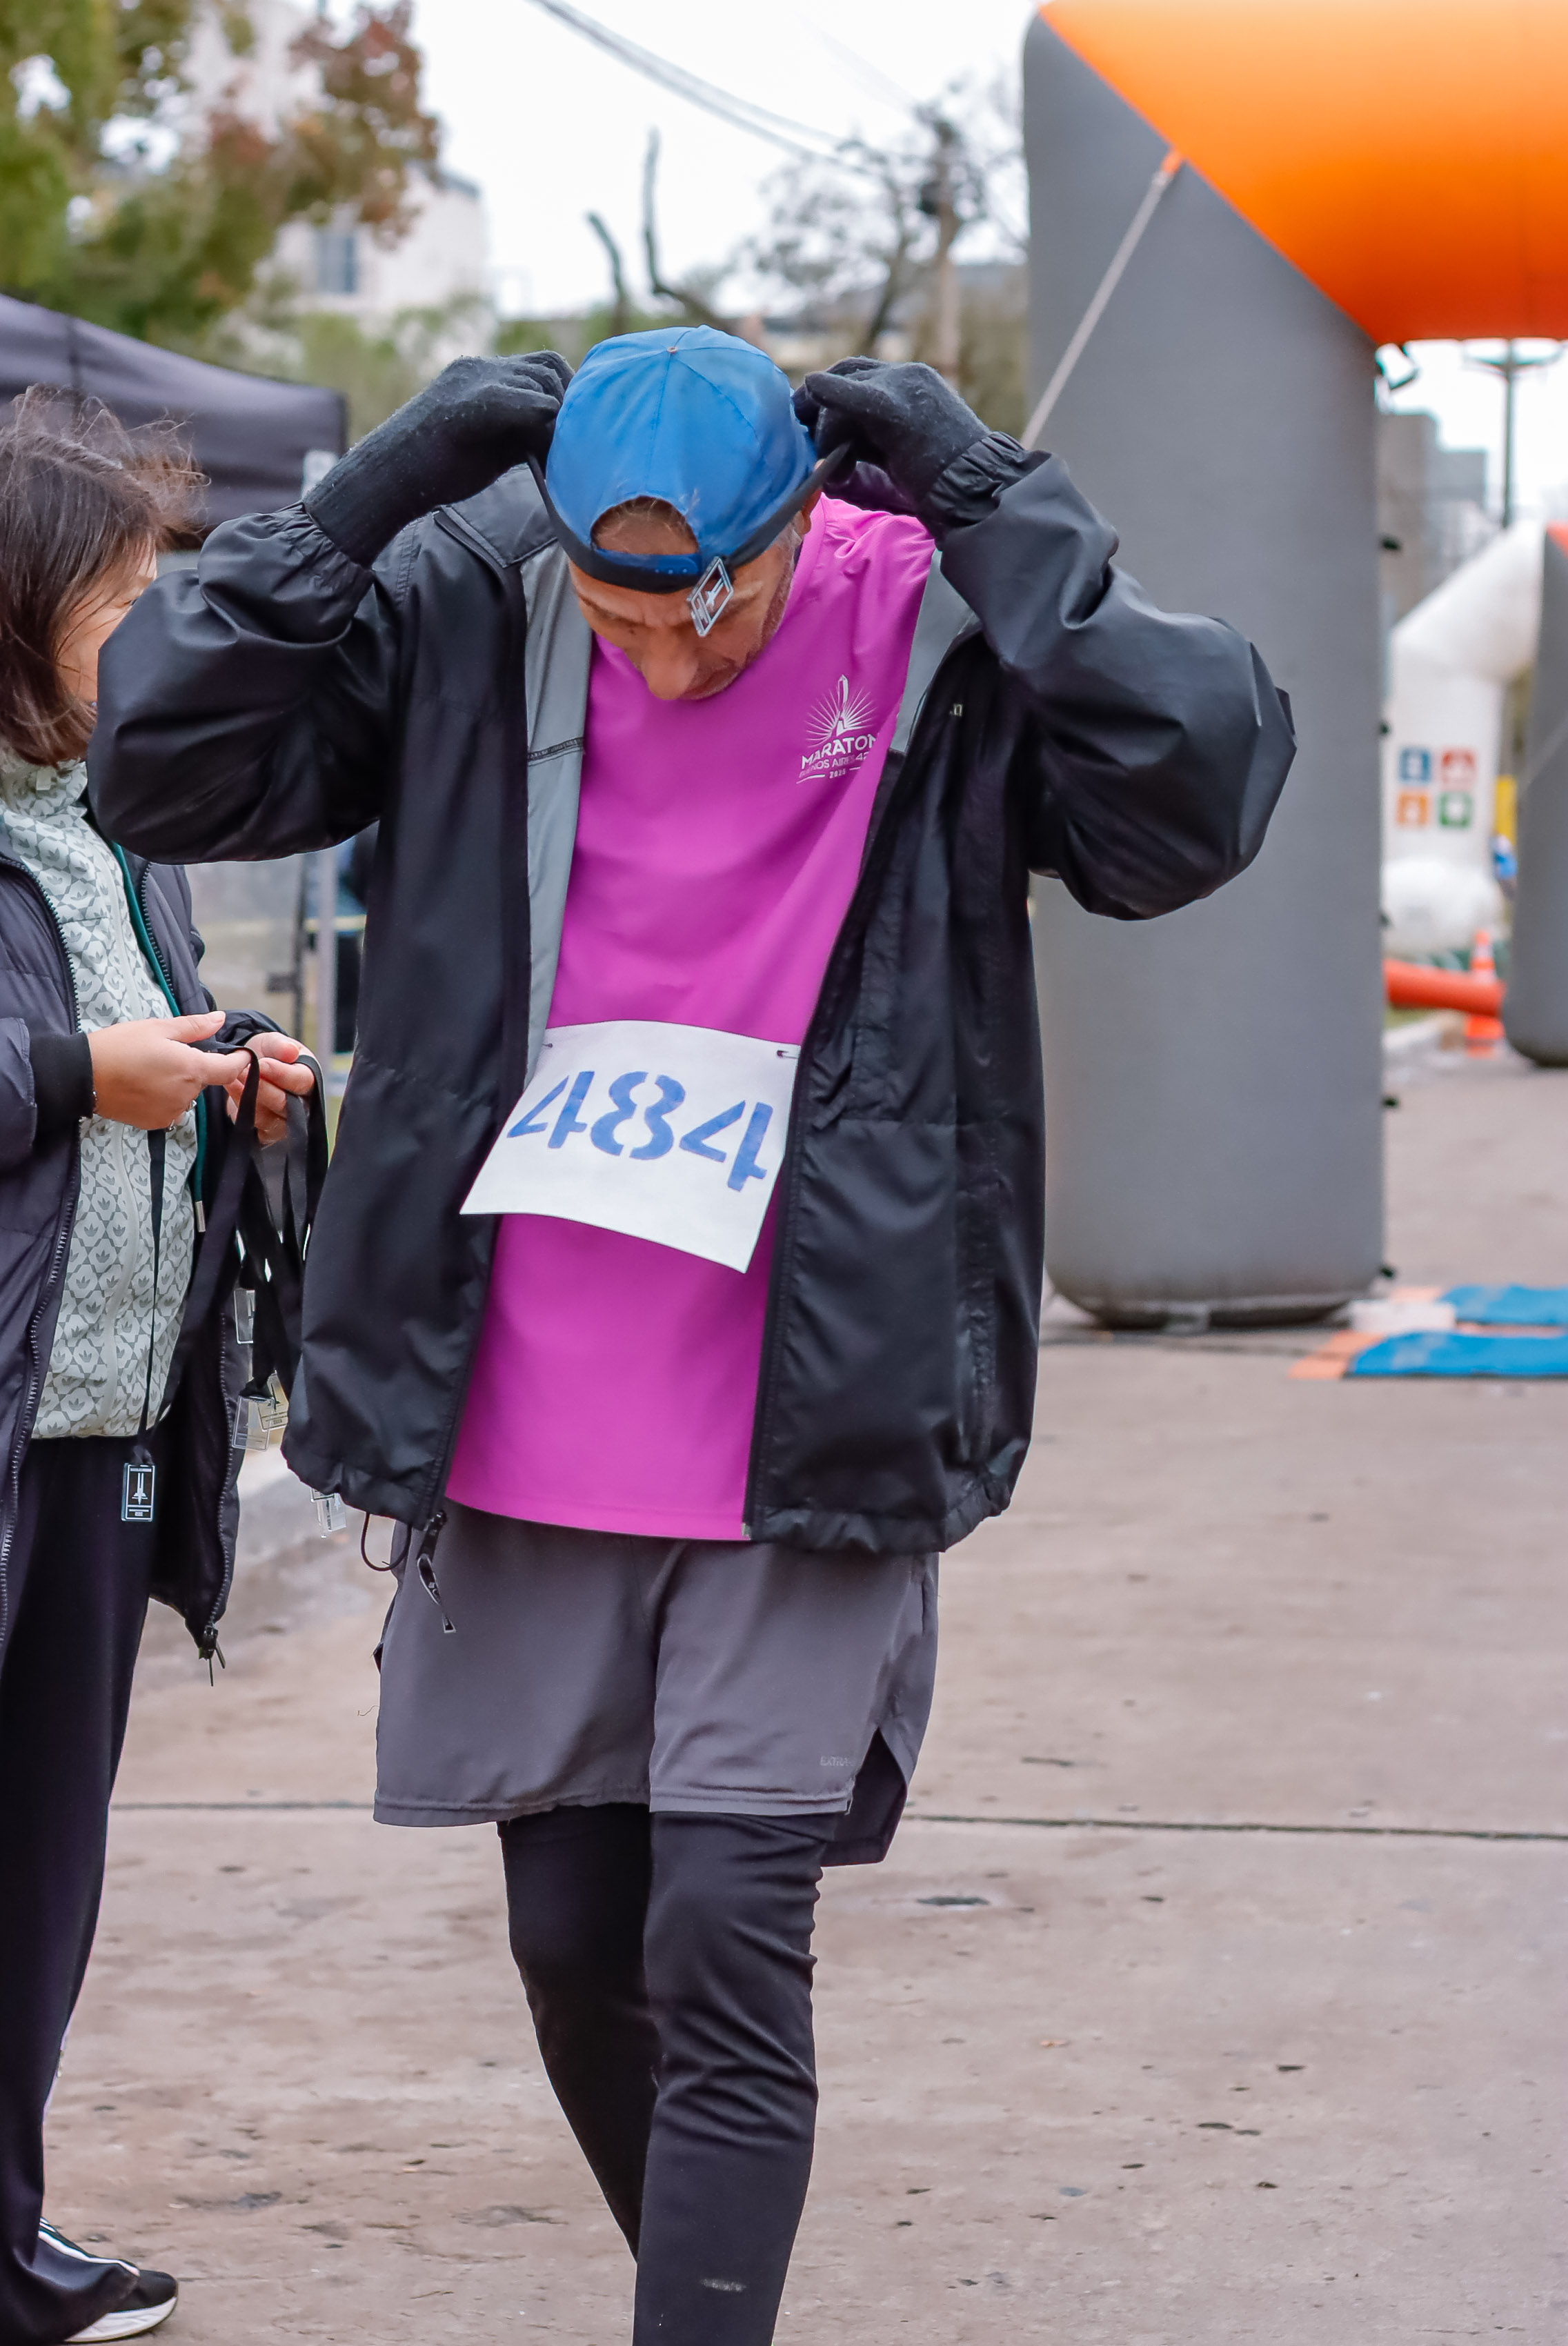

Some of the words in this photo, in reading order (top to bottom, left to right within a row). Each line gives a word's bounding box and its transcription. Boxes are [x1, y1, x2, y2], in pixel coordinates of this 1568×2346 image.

[799, 759, 830, 778] NOS
[832, 755, 855, 768] AIRE
[506, 1071, 774, 1192] 484
